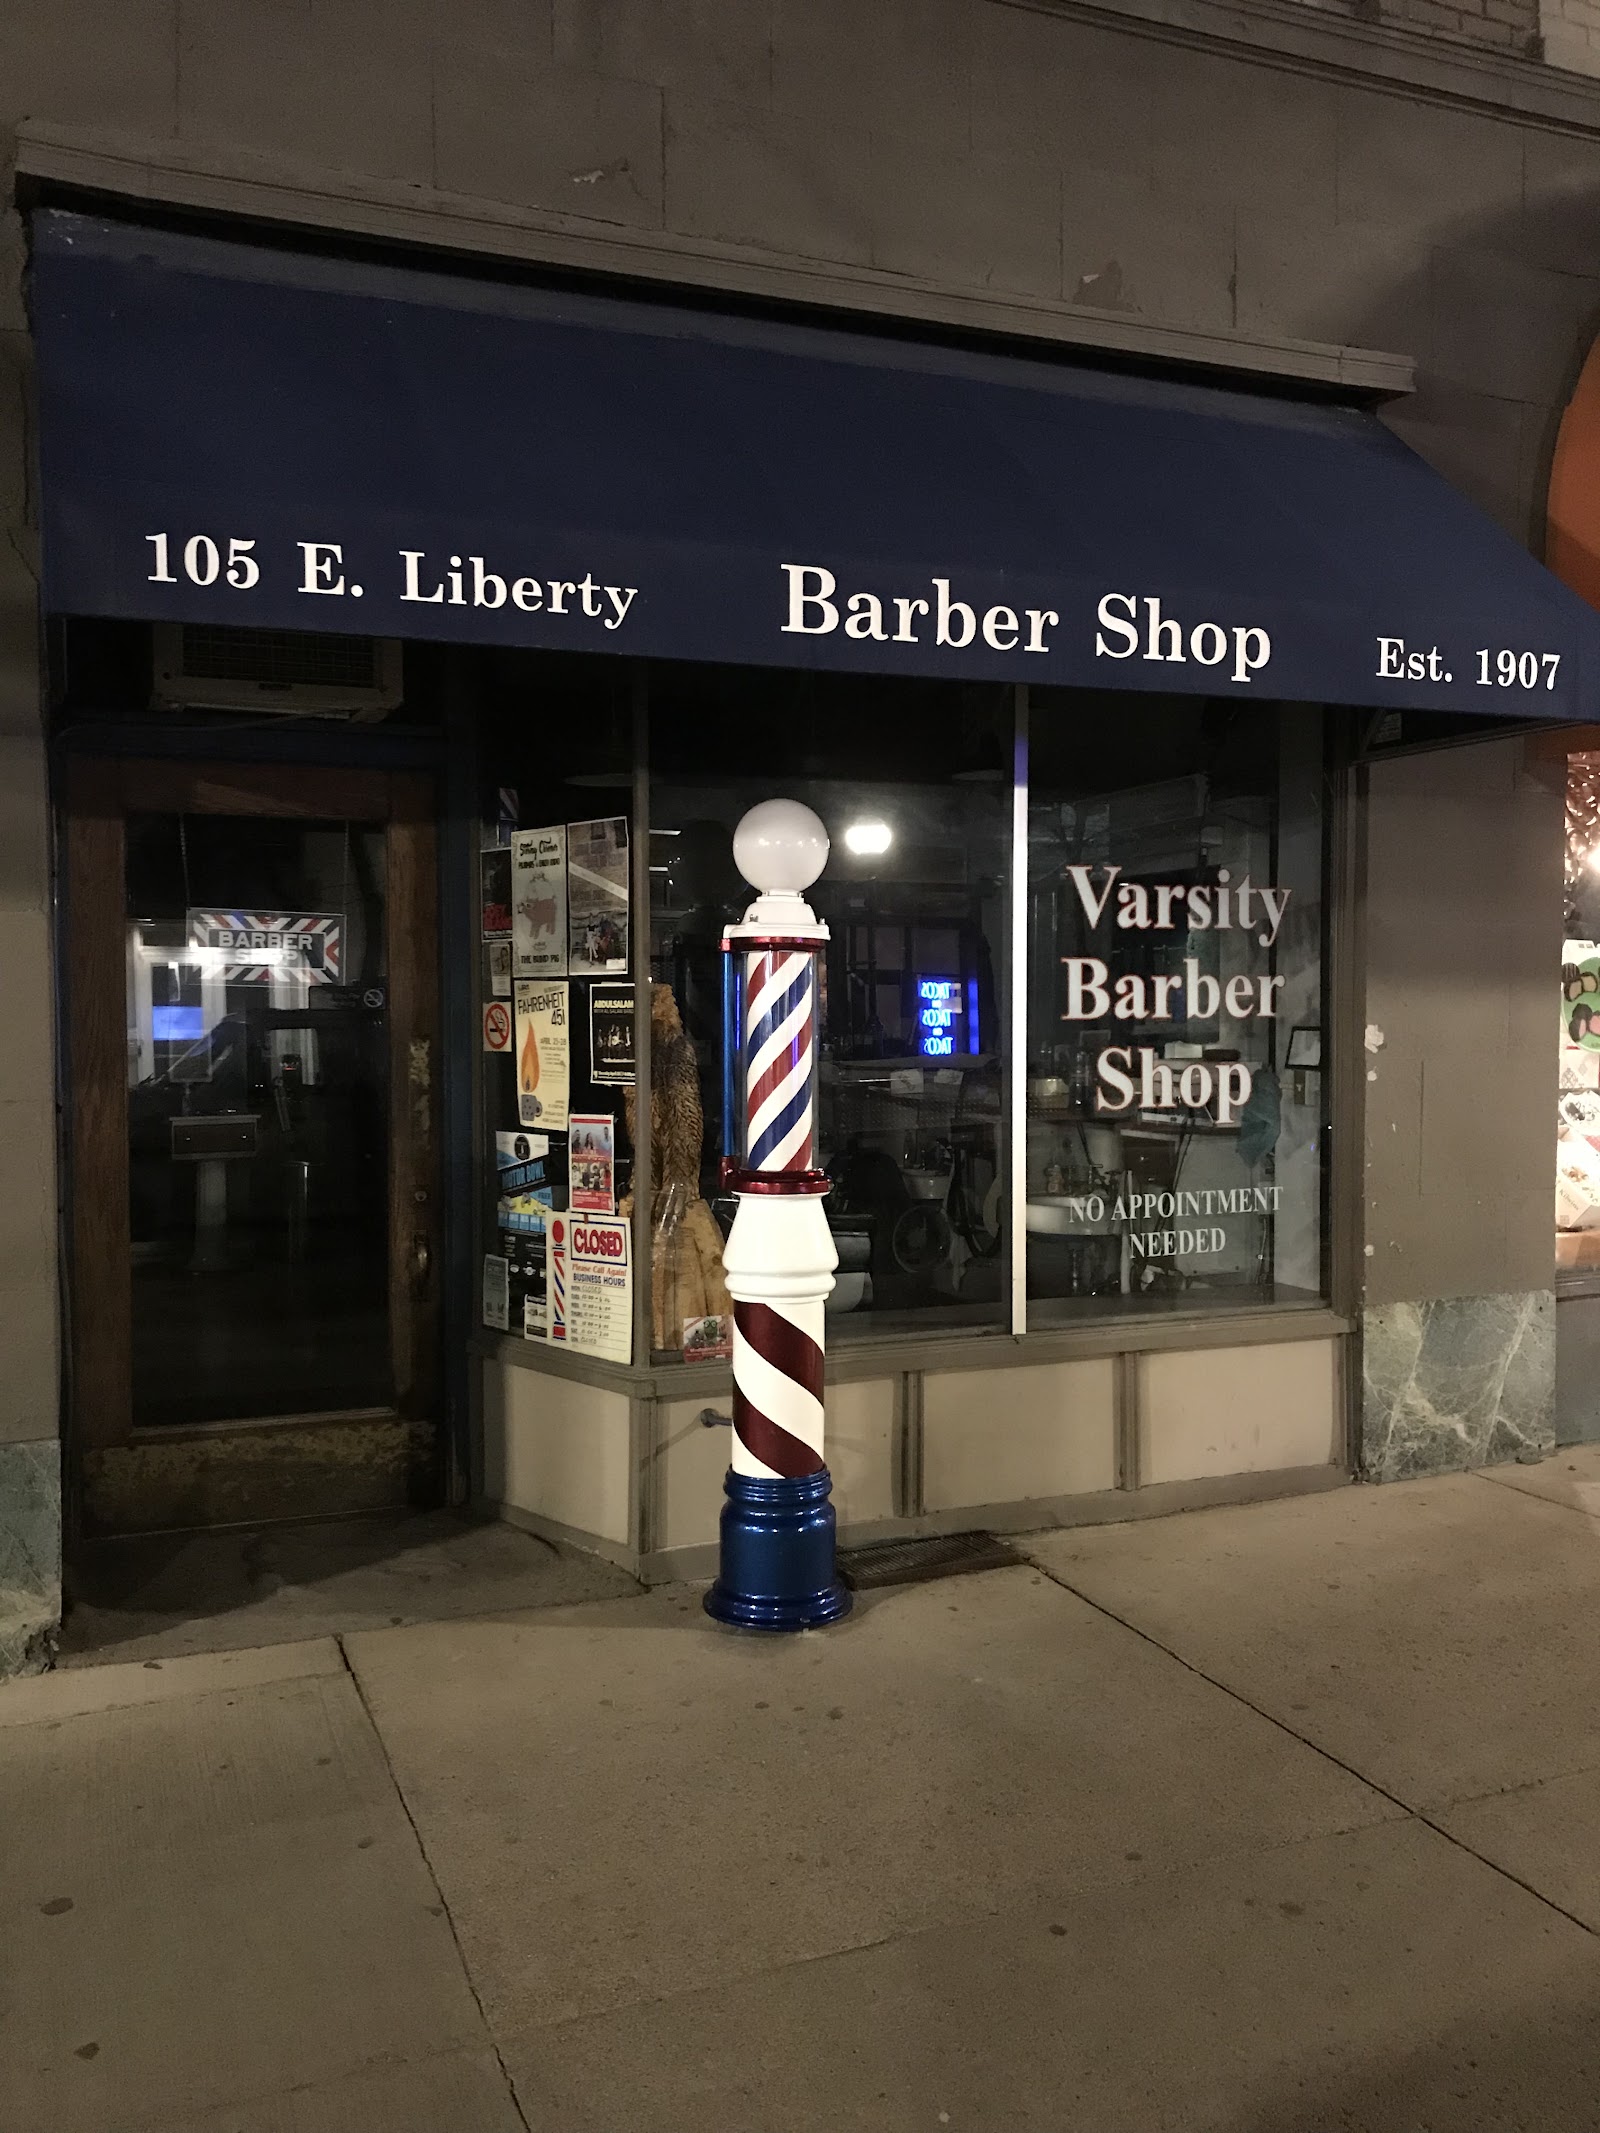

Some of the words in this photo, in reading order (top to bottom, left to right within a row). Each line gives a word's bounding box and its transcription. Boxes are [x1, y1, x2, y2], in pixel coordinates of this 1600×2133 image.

[145, 532, 260, 589] 105
[297, 541, 364, 598] E.
[398, 549, 639, 631] Liberty
[779, 563, 1060, 653] Barber
[1095, 592, 1272, 683] Shop
[1375, 636, 1453, 683] Est.
[1475, 648, 1562, 691] 1907
[1065, 864, 1292, 947] Varsity
[219, 931, 312, 949] BARBER
[235, 948, 299, 964] SP
[517, 991, 564, 1015] FAHRENHEIT
[1060, 956, 1286, 1020] Barber
[551, 1008, 566, 1026] 451
[1096, 1046, 1253, 1124] Shop
[1069, 1195, 1105, 1224] NO
[1111, 1185, 1284, 1221] APPOINTMENT
[573, 1227, 623, 1257] CLOSED
[1129, 1226, 1227, 1260] NEEDED
[572, 1263, 591, 1273] Please
[593, 1265, 605, 1274] Call
[606, 1267, 627, 1277] Again!
[573, 1273, 602, 1284] BUSINESS
[603, 1276, 626, 1287] HOURS
